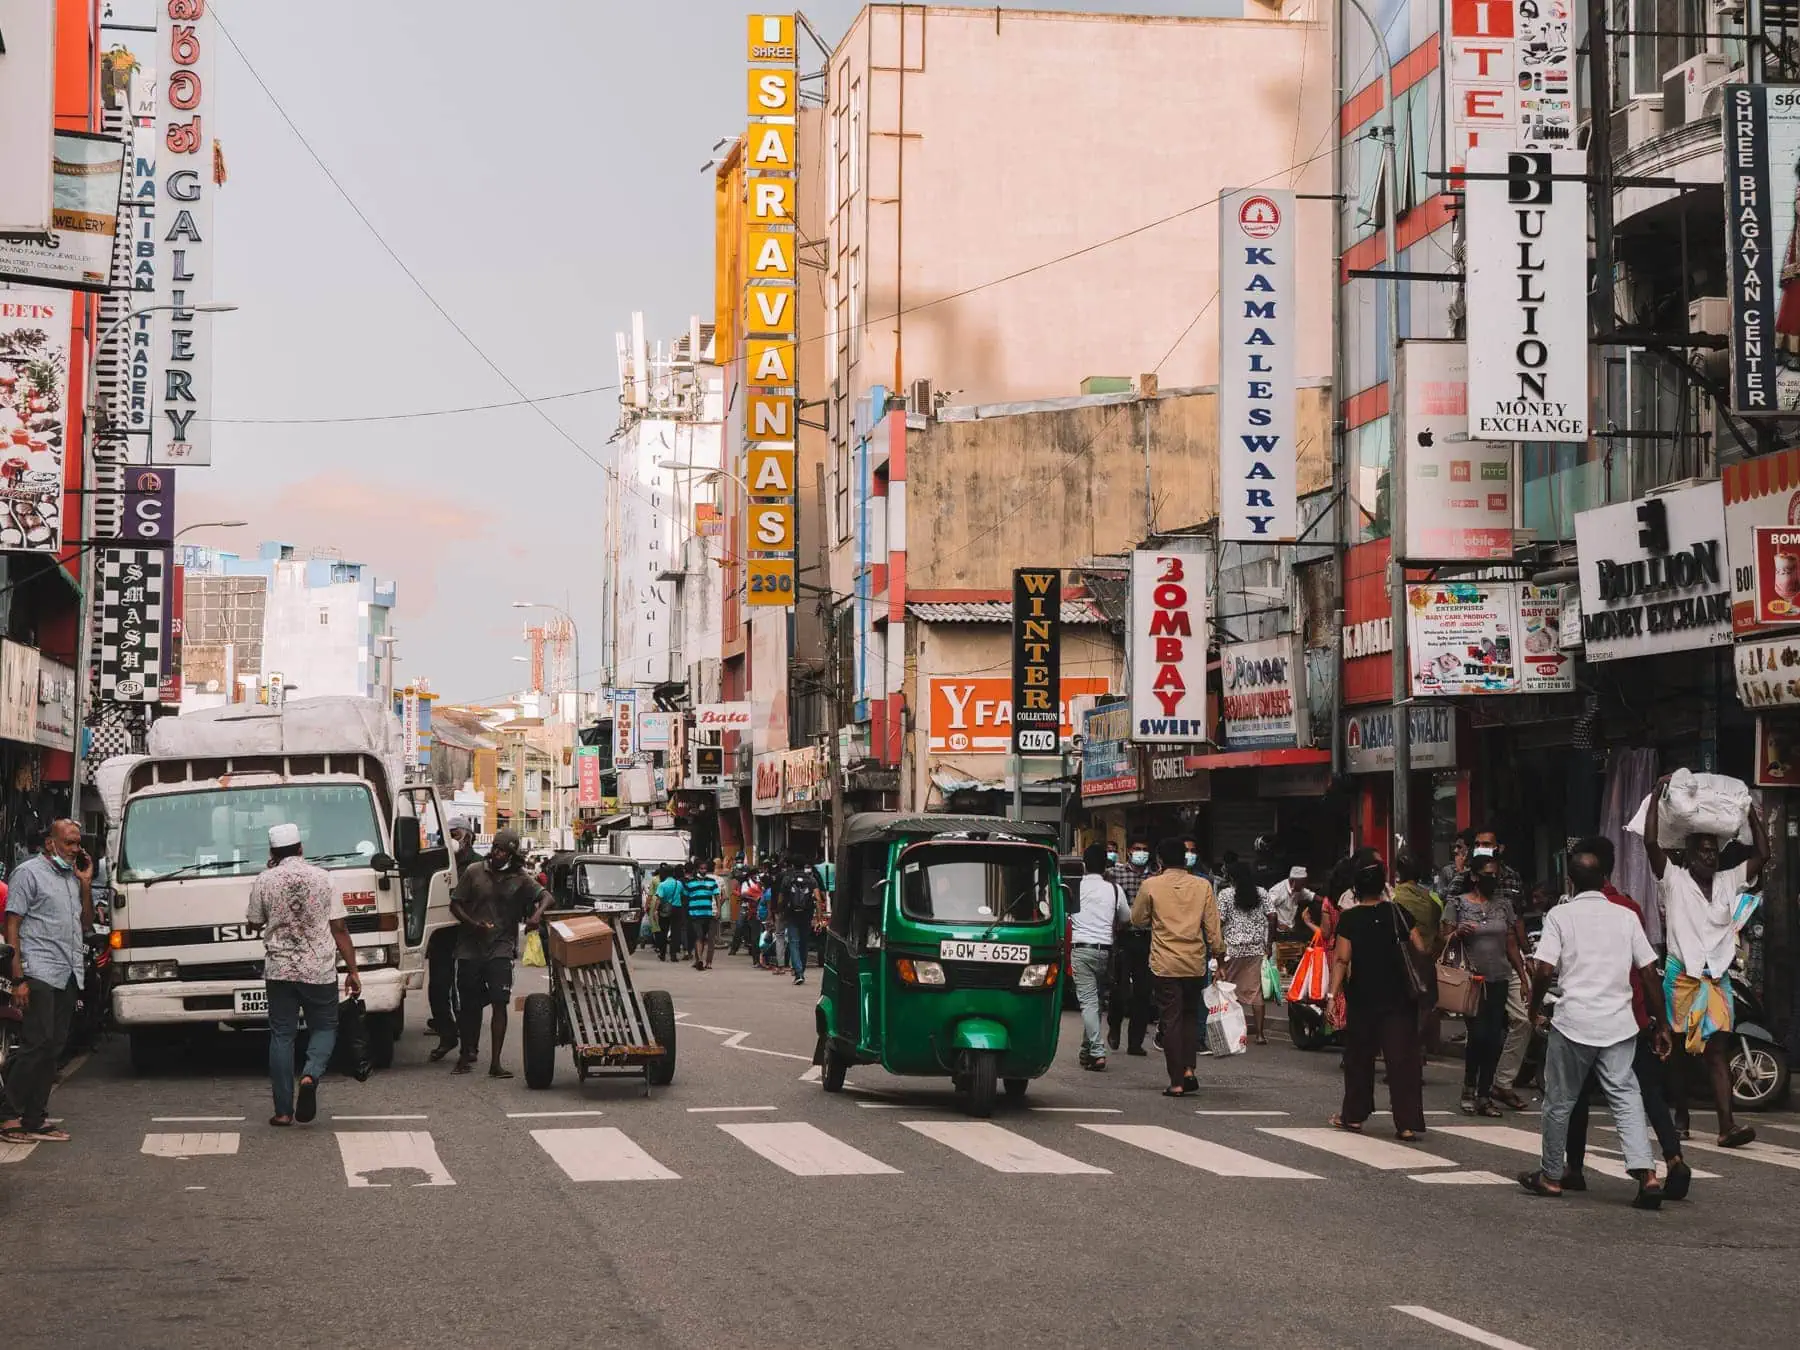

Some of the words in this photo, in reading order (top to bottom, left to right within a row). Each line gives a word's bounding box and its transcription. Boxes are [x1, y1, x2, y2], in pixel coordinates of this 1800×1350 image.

[752, 46, 793, 58] SHREE
[1735, 90, 1755, 168] SHREE
[136, 158, 156, 291] MALIBAN
[1739, 175, 1762, 302] BHAGAVAN
[1508, 152, 1552, 401] BULLION
[165, 170, 202, 441] GALLERY
[754, 75, 788, 545] SARAVANAS
[131, 314, 152, 424] TRADERS
[1742, 310, 1765, 406] CENTER
[1240, 247, 1280, 534] KAMALESWARY
[1496, 401, 1568, 417] MONEY
[1480, 418, 1583, 434] EXCHANGE
[751, 574, 791, 593] 230
[1735, 565, 1754, 593] BO
[121, 564, 144, 672] SMASH
[1521, 608, 1543, 617] BABY
[1584, 605, 1644, 642] MONEY
[1020, 574, 1055, 709] WINTER
[120, 681, 139, 693] 251
[699, 711, 750, 724] Bata
[940, 685, 976, 729] Y
[1017, 711, 1058, 721] COLLECTION
[618, 703, 632, 754] BOMBAY
[951, 736, 967, 747] 140
[1139, 719, 1201, 735] SWEET
[701, 775, 718, 785] 234
[956, 943, 976, 958] QW
[991, 946, 1028, 961] 6525
